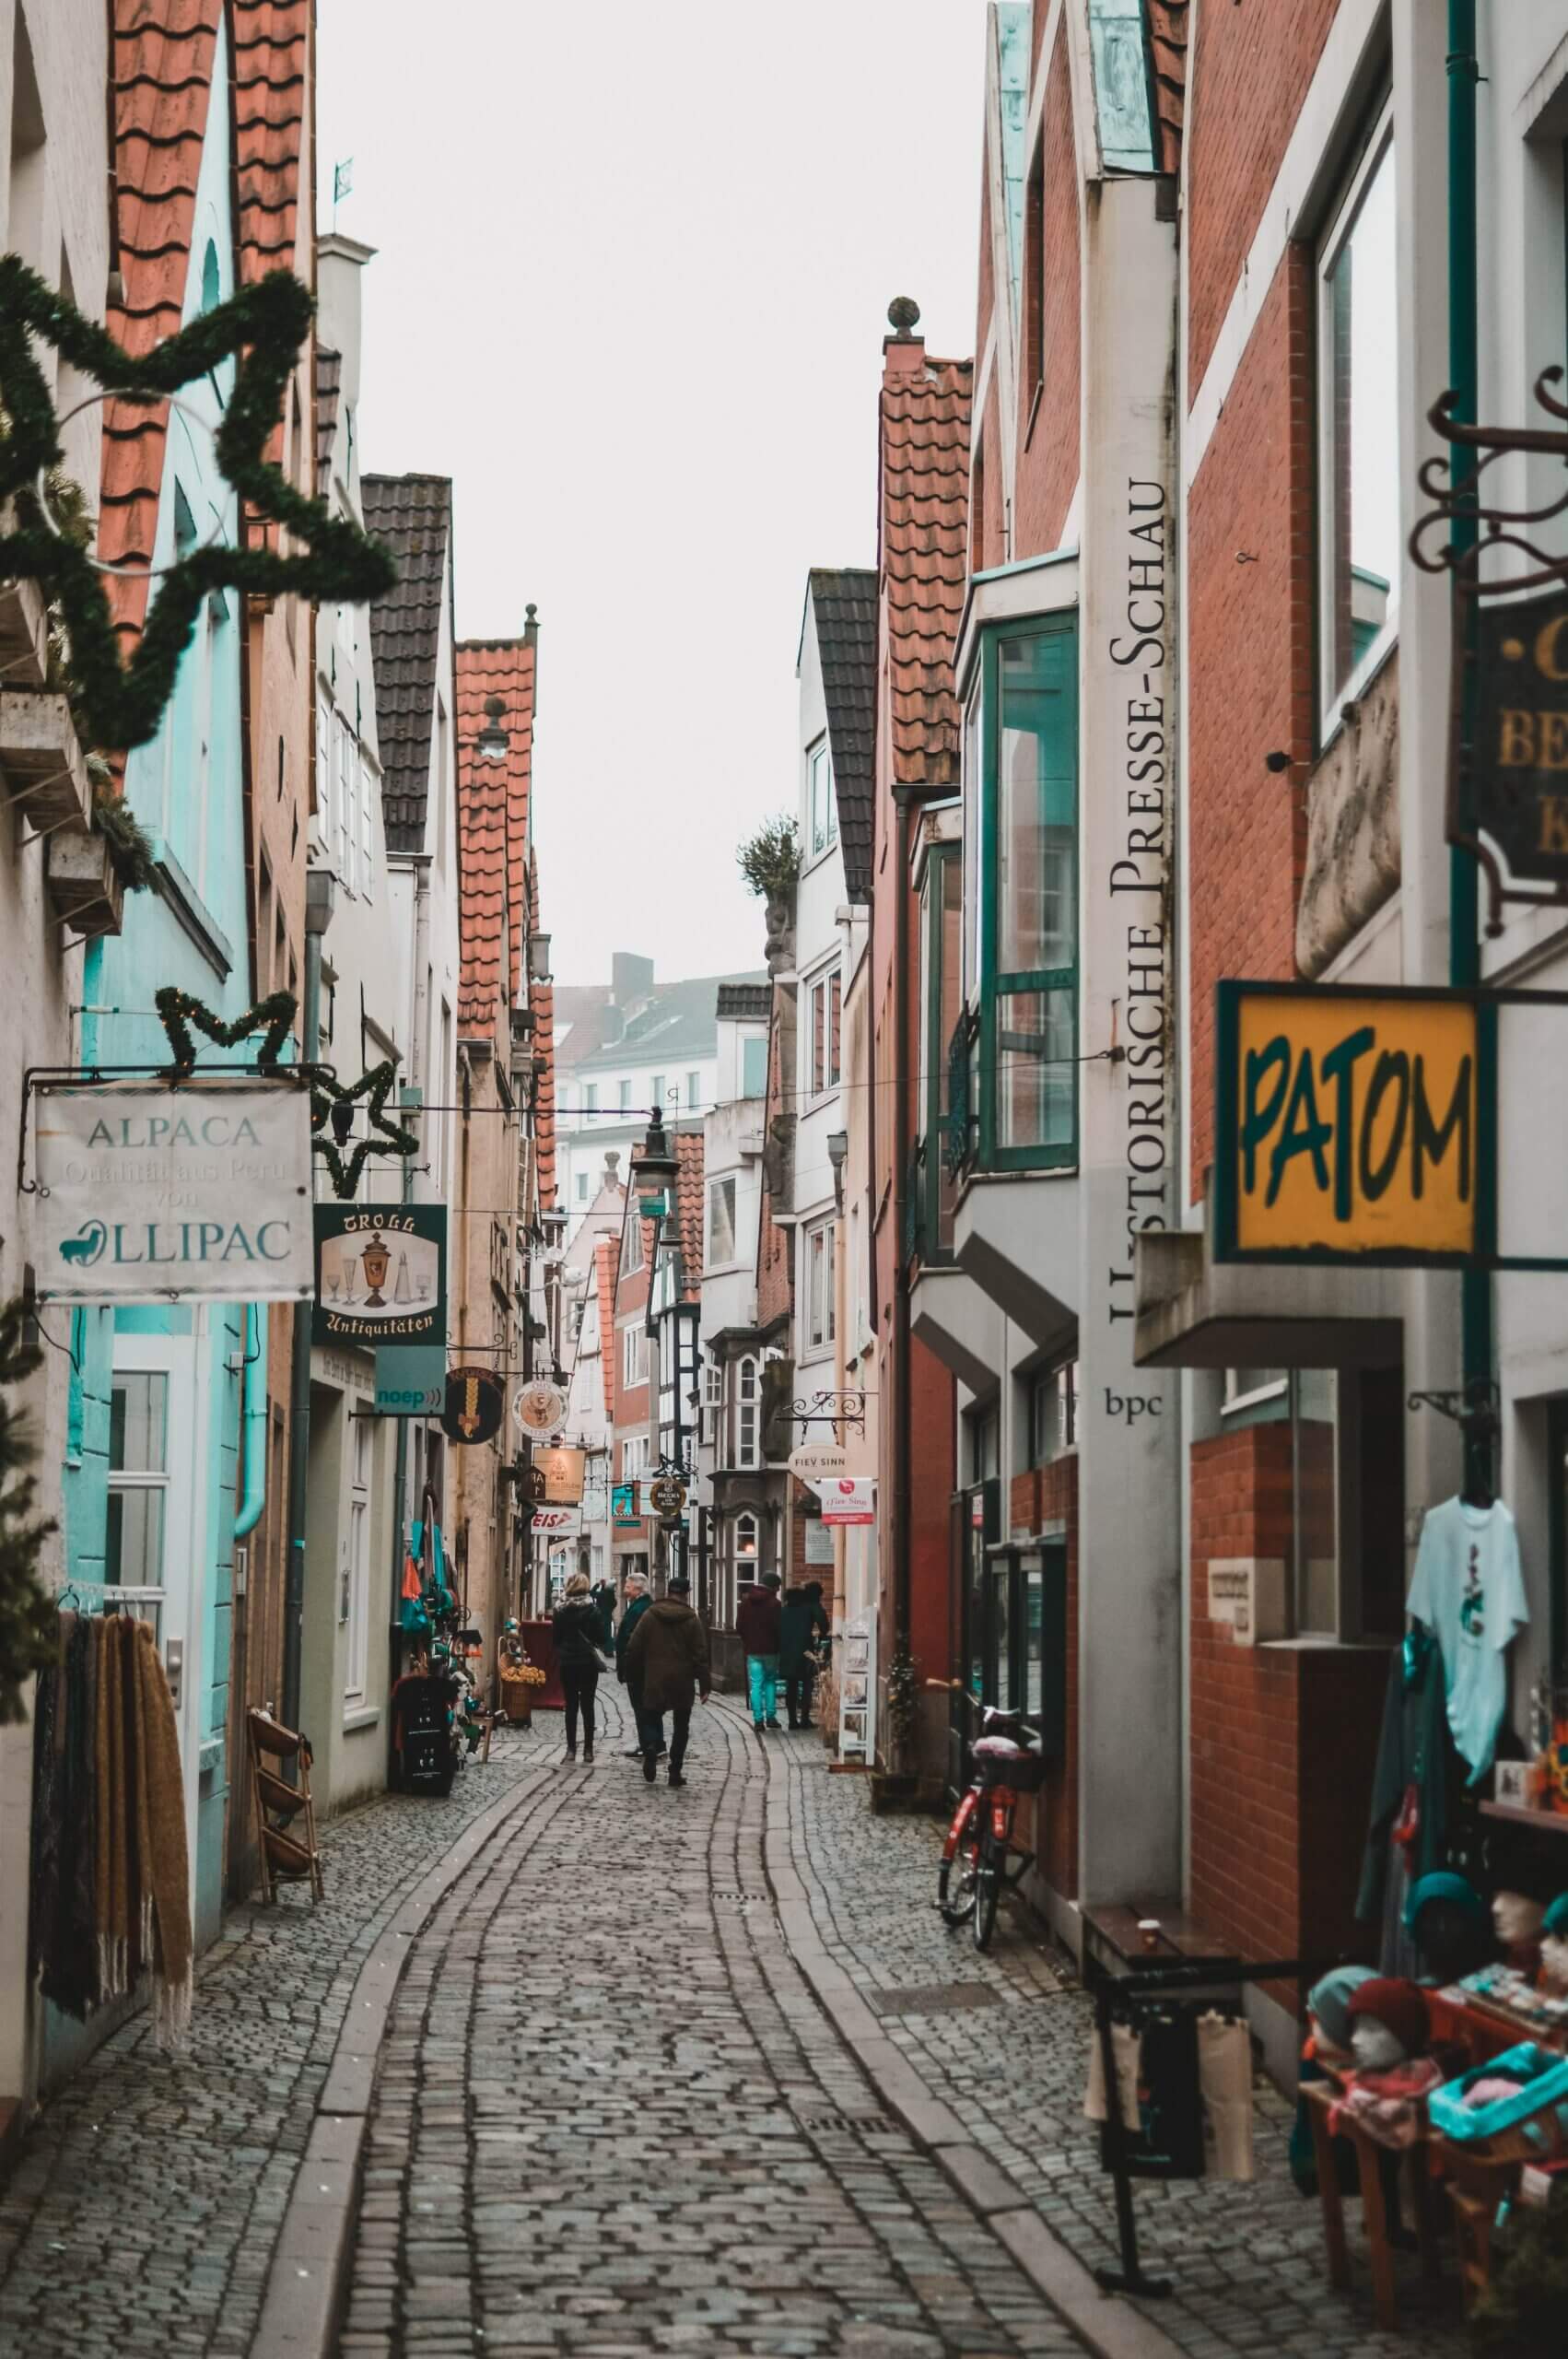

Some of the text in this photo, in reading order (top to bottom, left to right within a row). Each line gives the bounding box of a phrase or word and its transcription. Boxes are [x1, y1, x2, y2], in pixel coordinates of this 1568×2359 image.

[1108, 476, 1166, 898] PRESSE-SCHAU
[86, 1116, 263, 1148] ALPACA
[1240, 1026, 1472, 1223] PATOM
[343, 1213, 415, 1233] TROLL
[326, 1313, 434, 1338] Antiquitäten
[377, 1389, 425, 1409] noep
[1105, 1386, 1163, 1426] bpc
[820, 1457, 846, 1466] SINN
[532, 1513, 558, 1528] EIS
